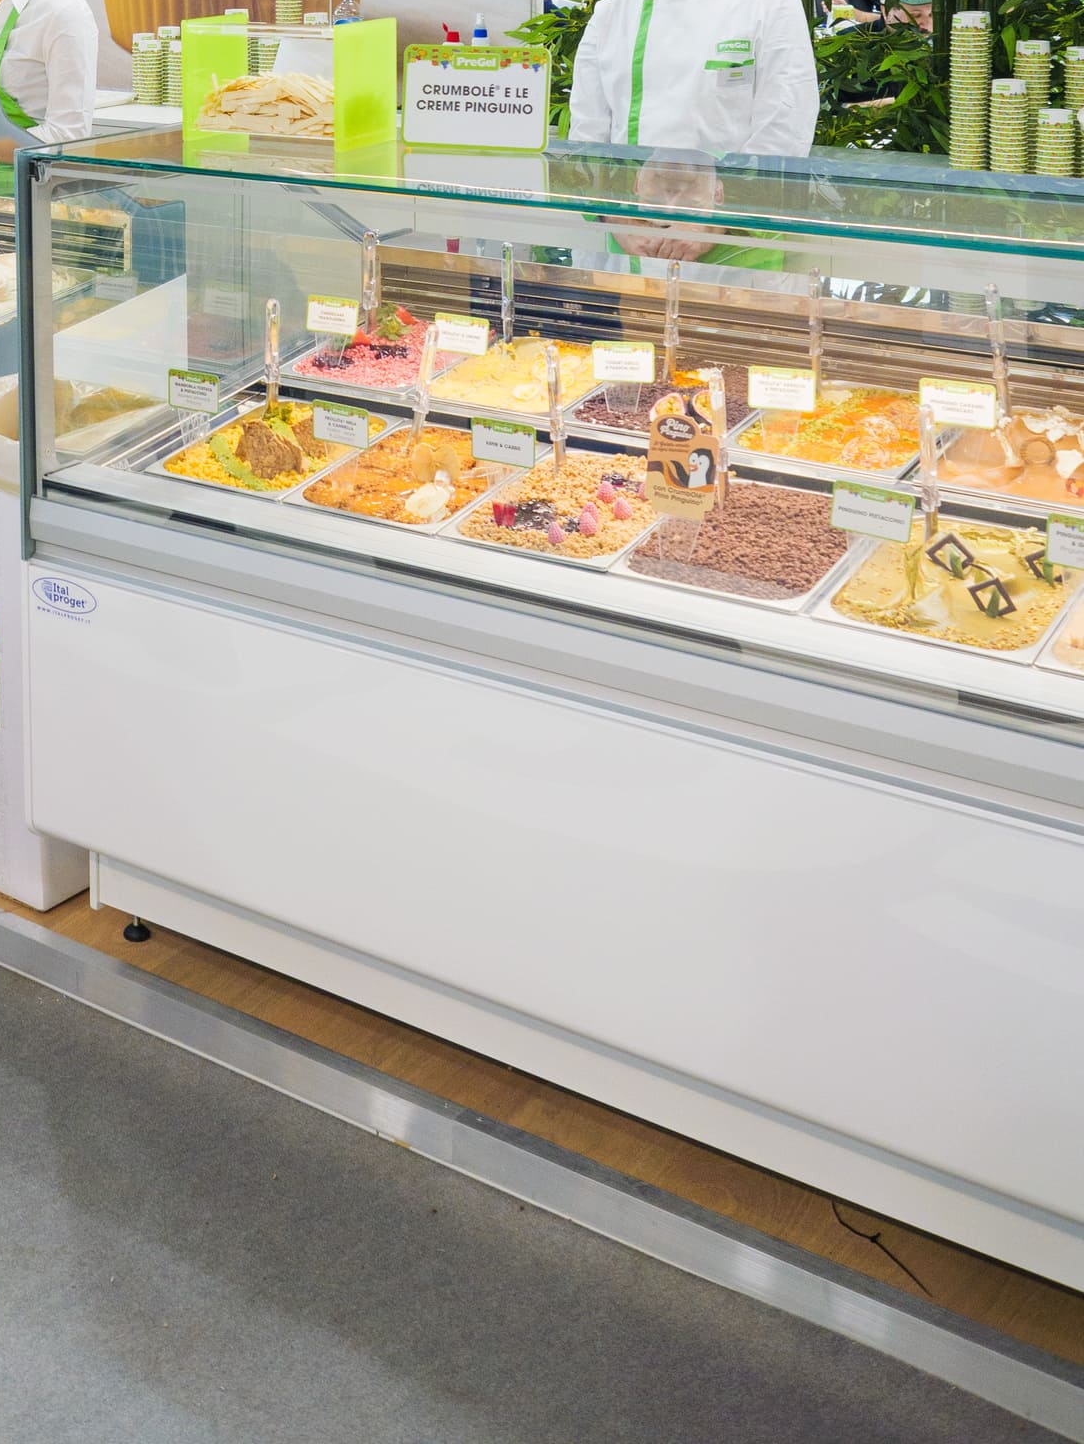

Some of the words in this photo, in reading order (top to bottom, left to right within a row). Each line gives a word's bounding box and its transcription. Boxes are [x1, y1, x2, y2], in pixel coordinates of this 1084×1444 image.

[456, 57, 496, 67] PreGel
[504, 87, 511, 97] E
[516, 87, 529, 98] LE
[416, 100, 461, 111] CREME
[465, 102, 533, 115] PINGUINO
[54, 582, 69, 596] Ital
[53, 594, 86, 609] proget
